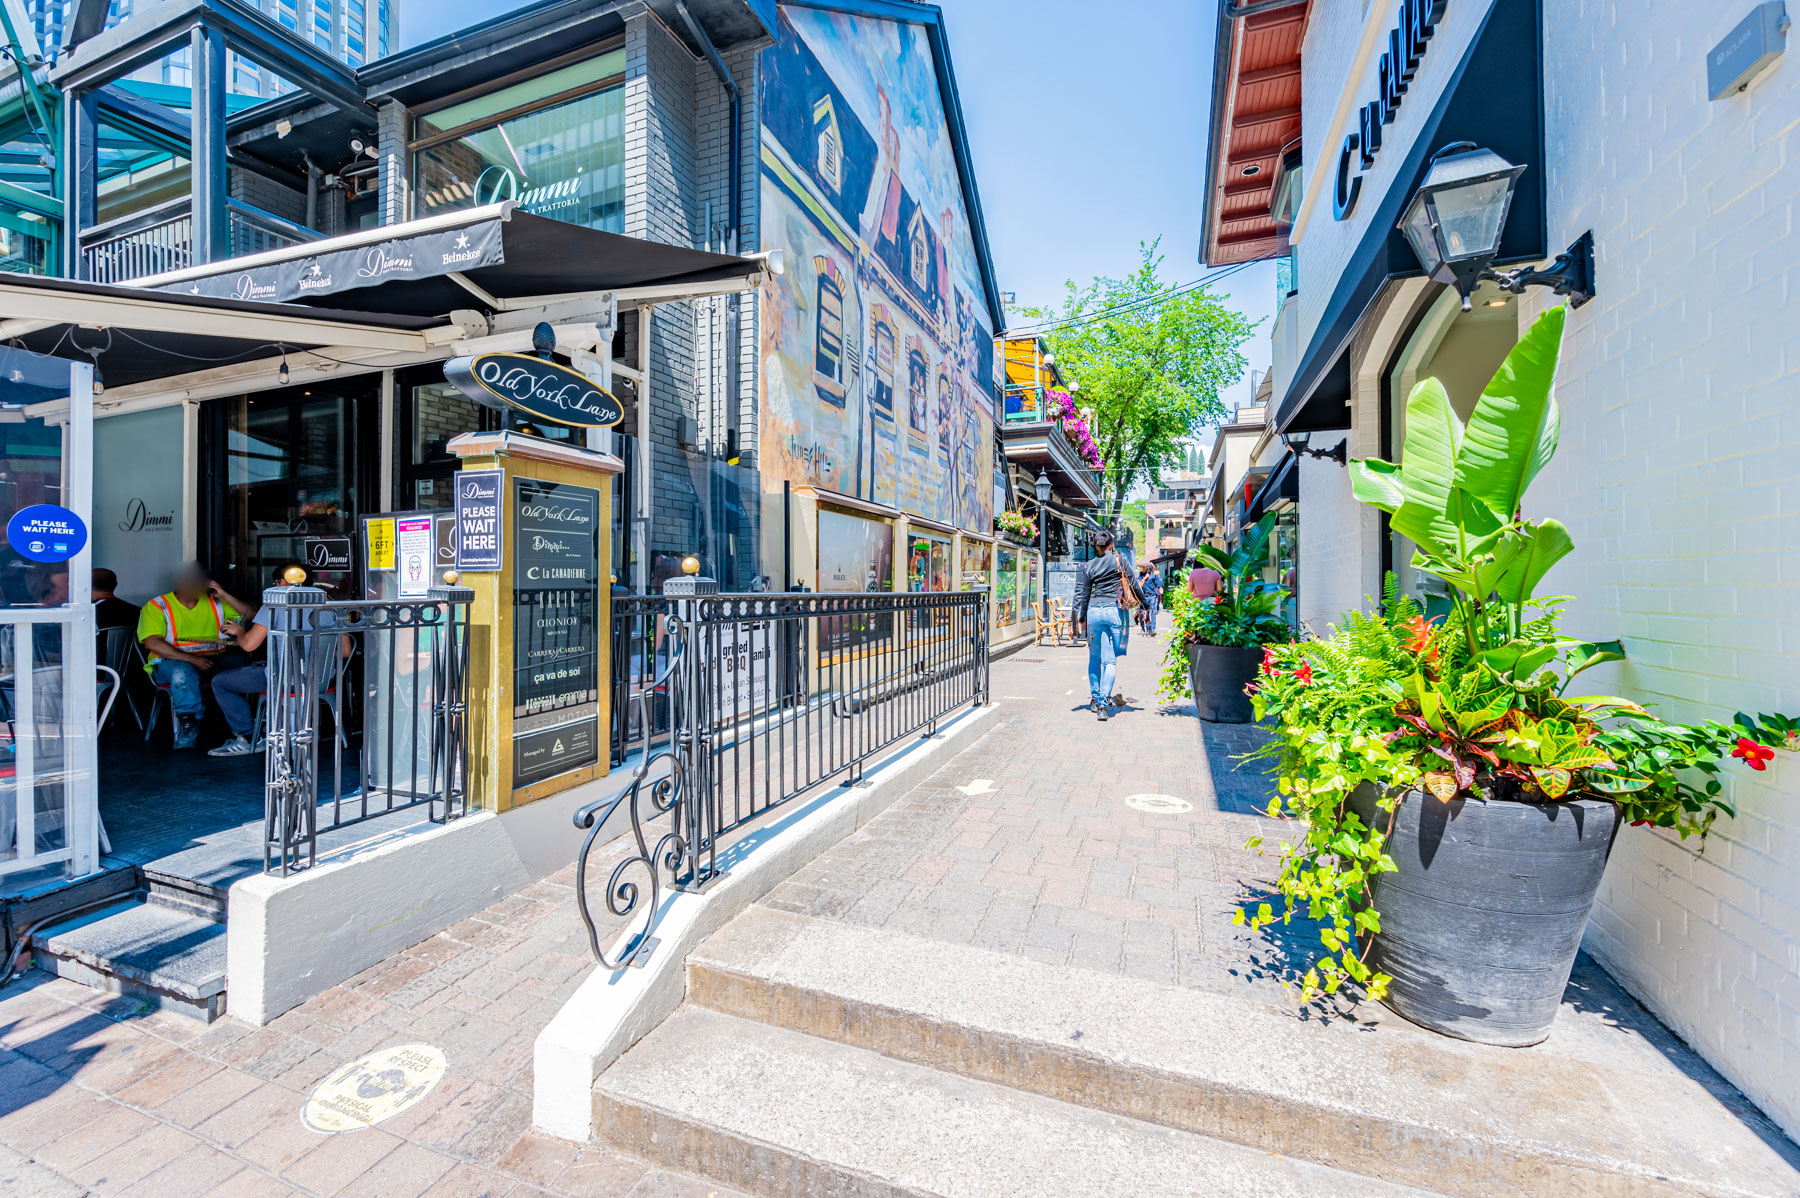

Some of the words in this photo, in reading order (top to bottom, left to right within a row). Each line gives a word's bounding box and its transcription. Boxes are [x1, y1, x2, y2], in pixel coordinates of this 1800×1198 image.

[537, 197, 581, 213] TRATTORIA
[357, 248, 413, 277] Dimmi
[443, 249, 481, 265] Heineken
[231, 274, 277, 300] Dimmi
[299, 275, 332, 290] Heineken
[480, 361, 527, 390] Old
[513, 374, 580, 410] York
[568, 390, 617, 422] Lane
[462, 482, 495, 499] Dimmi
[118, 497, 174, 532] Dimmi
[462, 506, 496, 518] PLEASE
[521, 505, 541, 517] Old
[537, 505, 568, 522] York
[564, 508, 590, 524] Lane
[22, 525, 48, 534] WAIT
[50, 527, 75, 535] HERE
[31, 519, 68, 528] PLEASE
[462, 519, 496, 534] WAIT
[375, 541, 389, 550] 6FT
[463, 535, 496, 550] HERE
[308, 544, 349, 567] Dimmi
[542, 568, 550, 579] La
[551, 568, 586, 579] CANADIENNE
[539, 590, 575, 608] KARIR
[722, 640, 748, 660] gried
[727, 655, 746, 673] BQ
[534, 674, 544, 685] ça
[546, 672, 556, 680] va
[557, 668, 567, 678] de
[569, 667, 580, 677] soi
[558, 689, 587, 703] emma
[387, 1055, 430, 1073] RESPECT
[334, 1094, 374, 1113] PHYSICAL
